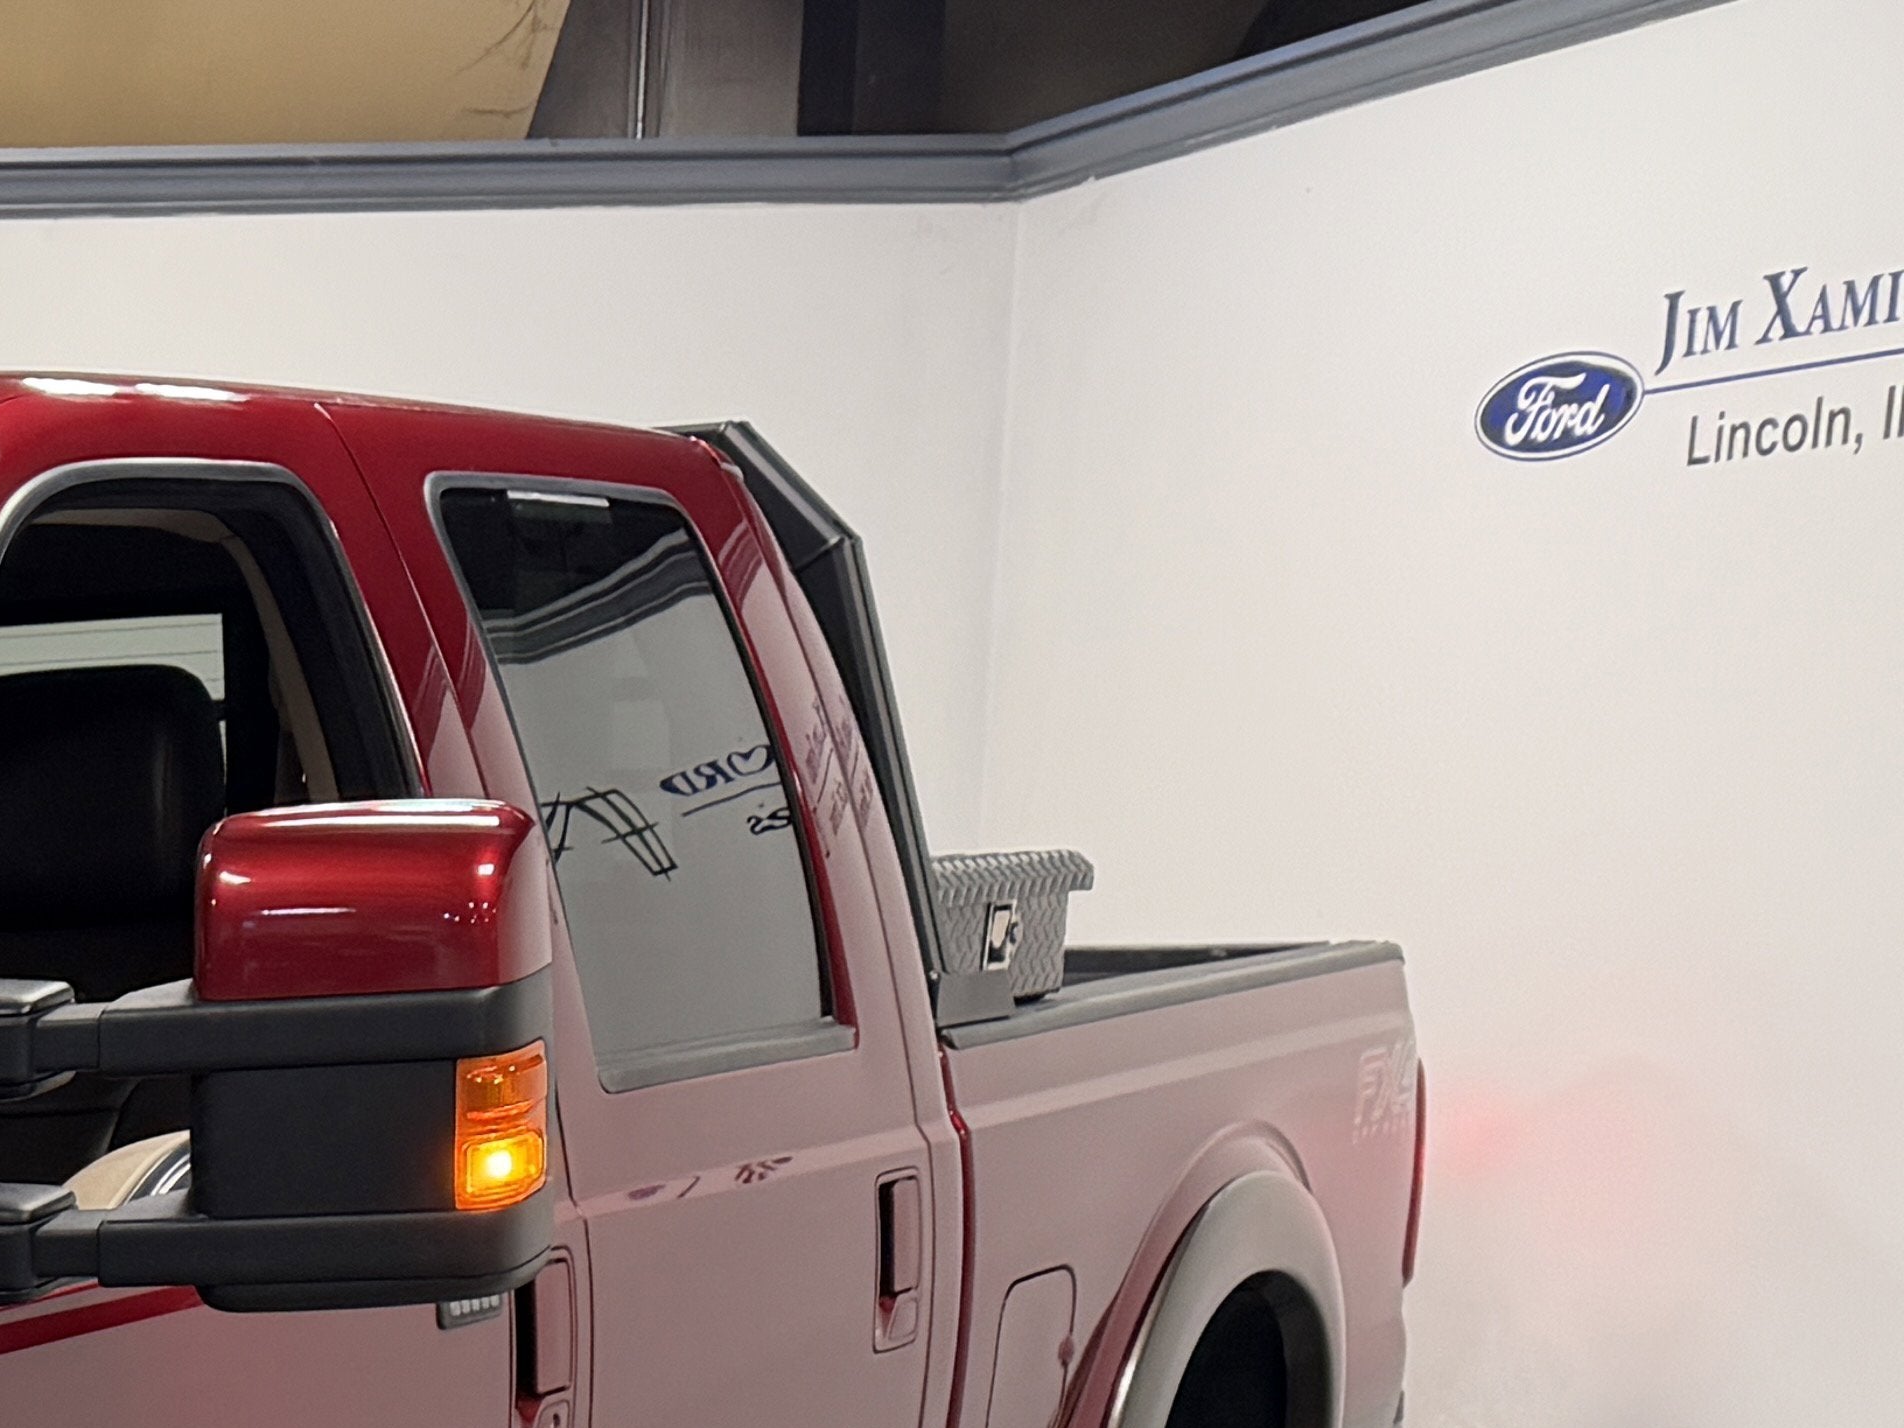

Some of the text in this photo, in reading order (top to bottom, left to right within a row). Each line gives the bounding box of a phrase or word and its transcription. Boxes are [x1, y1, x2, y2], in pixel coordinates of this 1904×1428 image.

[1654, 290, 1743, 376] JIM
[1503, 371, 1611, 448] Ford
[1686, 396, 1864, 467] Lincoln,
